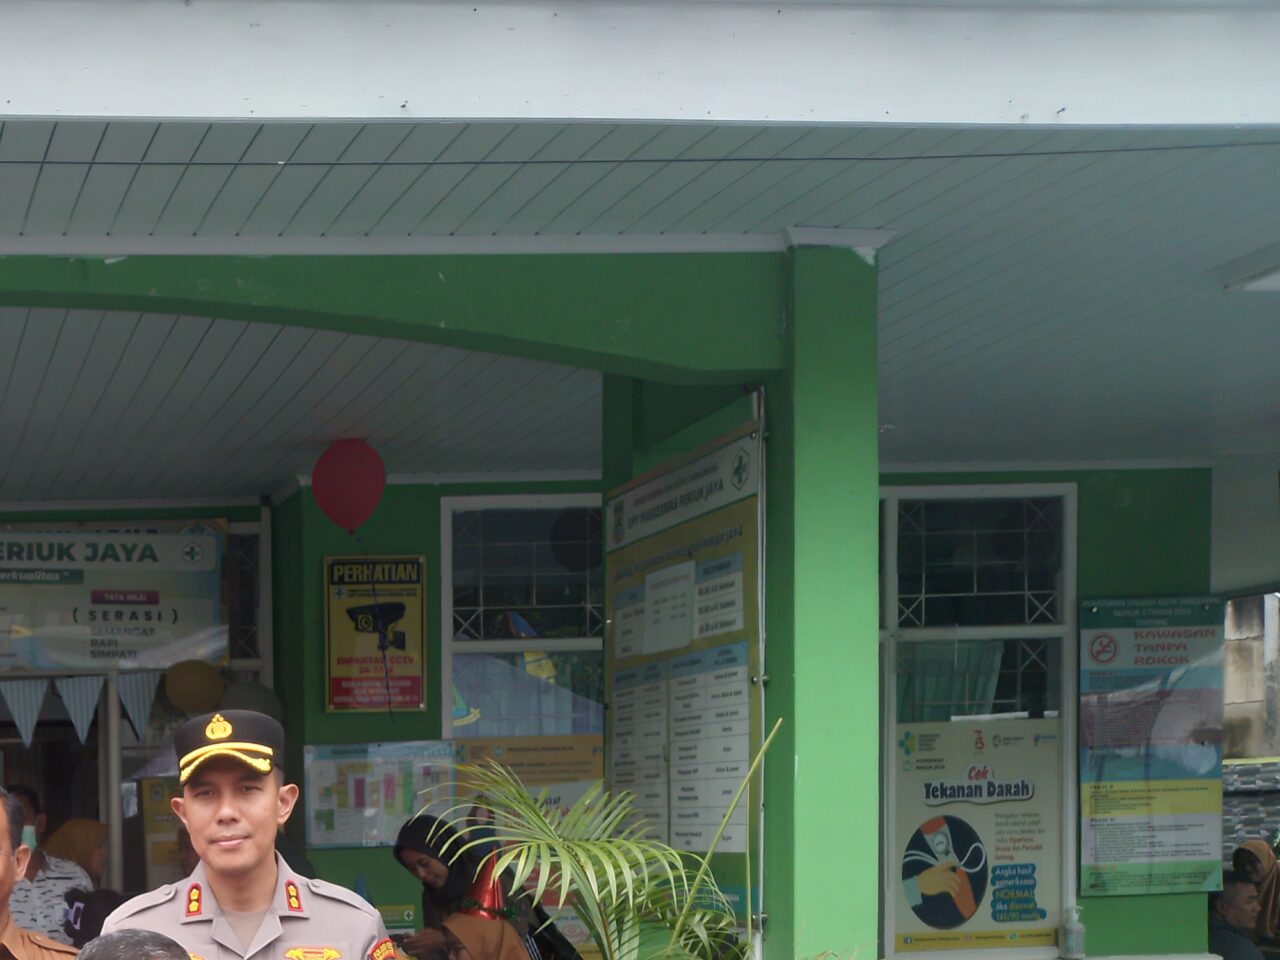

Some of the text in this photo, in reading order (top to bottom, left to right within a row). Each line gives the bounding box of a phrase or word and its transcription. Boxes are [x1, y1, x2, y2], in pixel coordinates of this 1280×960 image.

[640, 499, 678, 526] PUSKESMAS
[679, 488, 704, 509] PERIUK
[705, 478, 724, 501] JAYA
[726, 525, 744, 542] JAYA
[84, 543, 159, 563] JAYA
[333, 563, 418, 583] PERHATIAN
[104, 593, 127, 602] TATA
[90, 628, 155, 637] SEMANGAT
[1134, 628, 1216, 640] KAWASAN
[90, 638, 119, 648] RAPI
[1135, 642, 1187, 652] TANPA
[90, 650, 137, 659] SIMPATI
[1134, 655, 1189, 665] ROKOK
[967, 765, 989, 781] Cek
[924, 782, 983, 800] Tekanan
[995, 866, 1032, 878] Angka hasil
[995, 878, 1035, 889] pemeriksaan
[996, 889, 1034, 898] NORMAL
